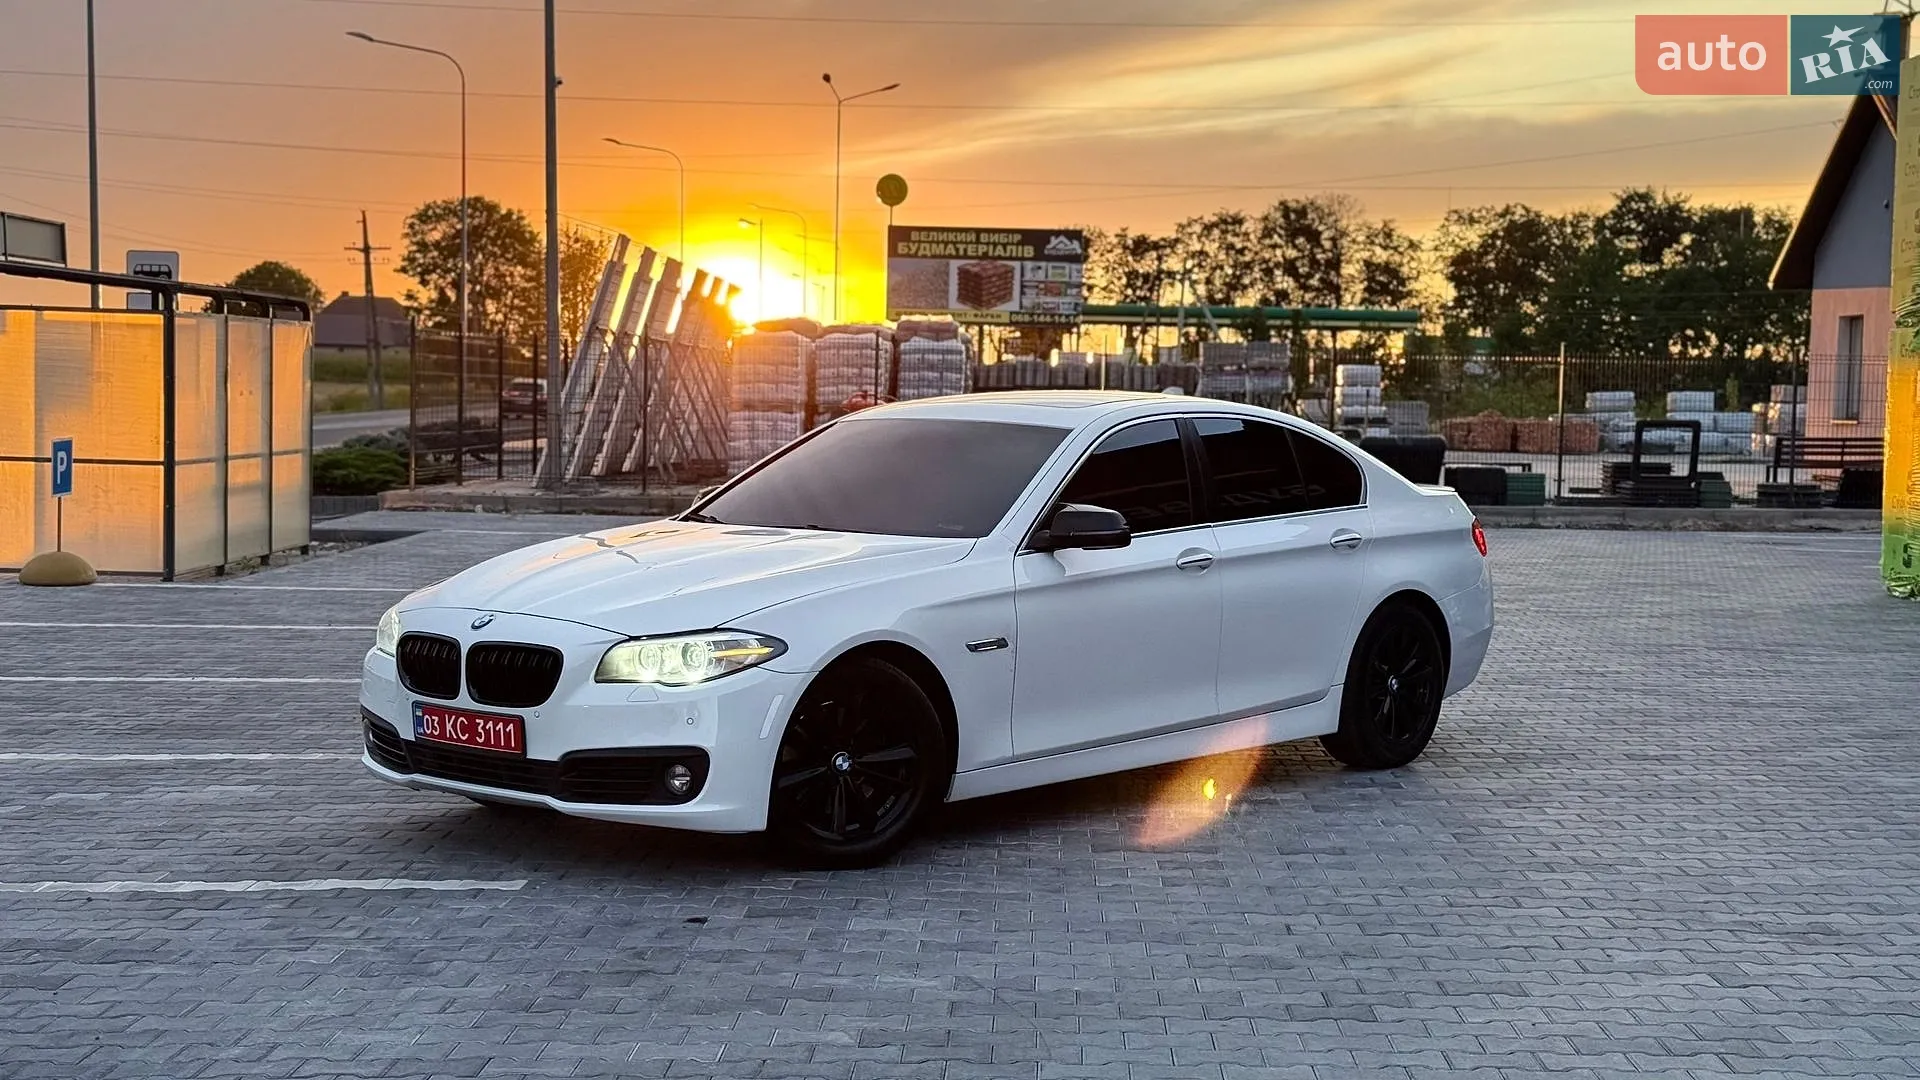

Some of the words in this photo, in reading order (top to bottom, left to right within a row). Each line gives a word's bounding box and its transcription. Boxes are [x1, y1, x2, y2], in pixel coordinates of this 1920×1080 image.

[911, 230, 976, 243] ВЕЛИКИЙ
[979, 232, 1022, 244] ВИБІР
[897, 242, 1034, 257] БУДМАТЕРІАЛІВ
[57, 450, 68, 485] P
[423, 714, 440, 735] 03
[445, 713, 469, 740] KC
[475, 718, 515, 747] 3111
